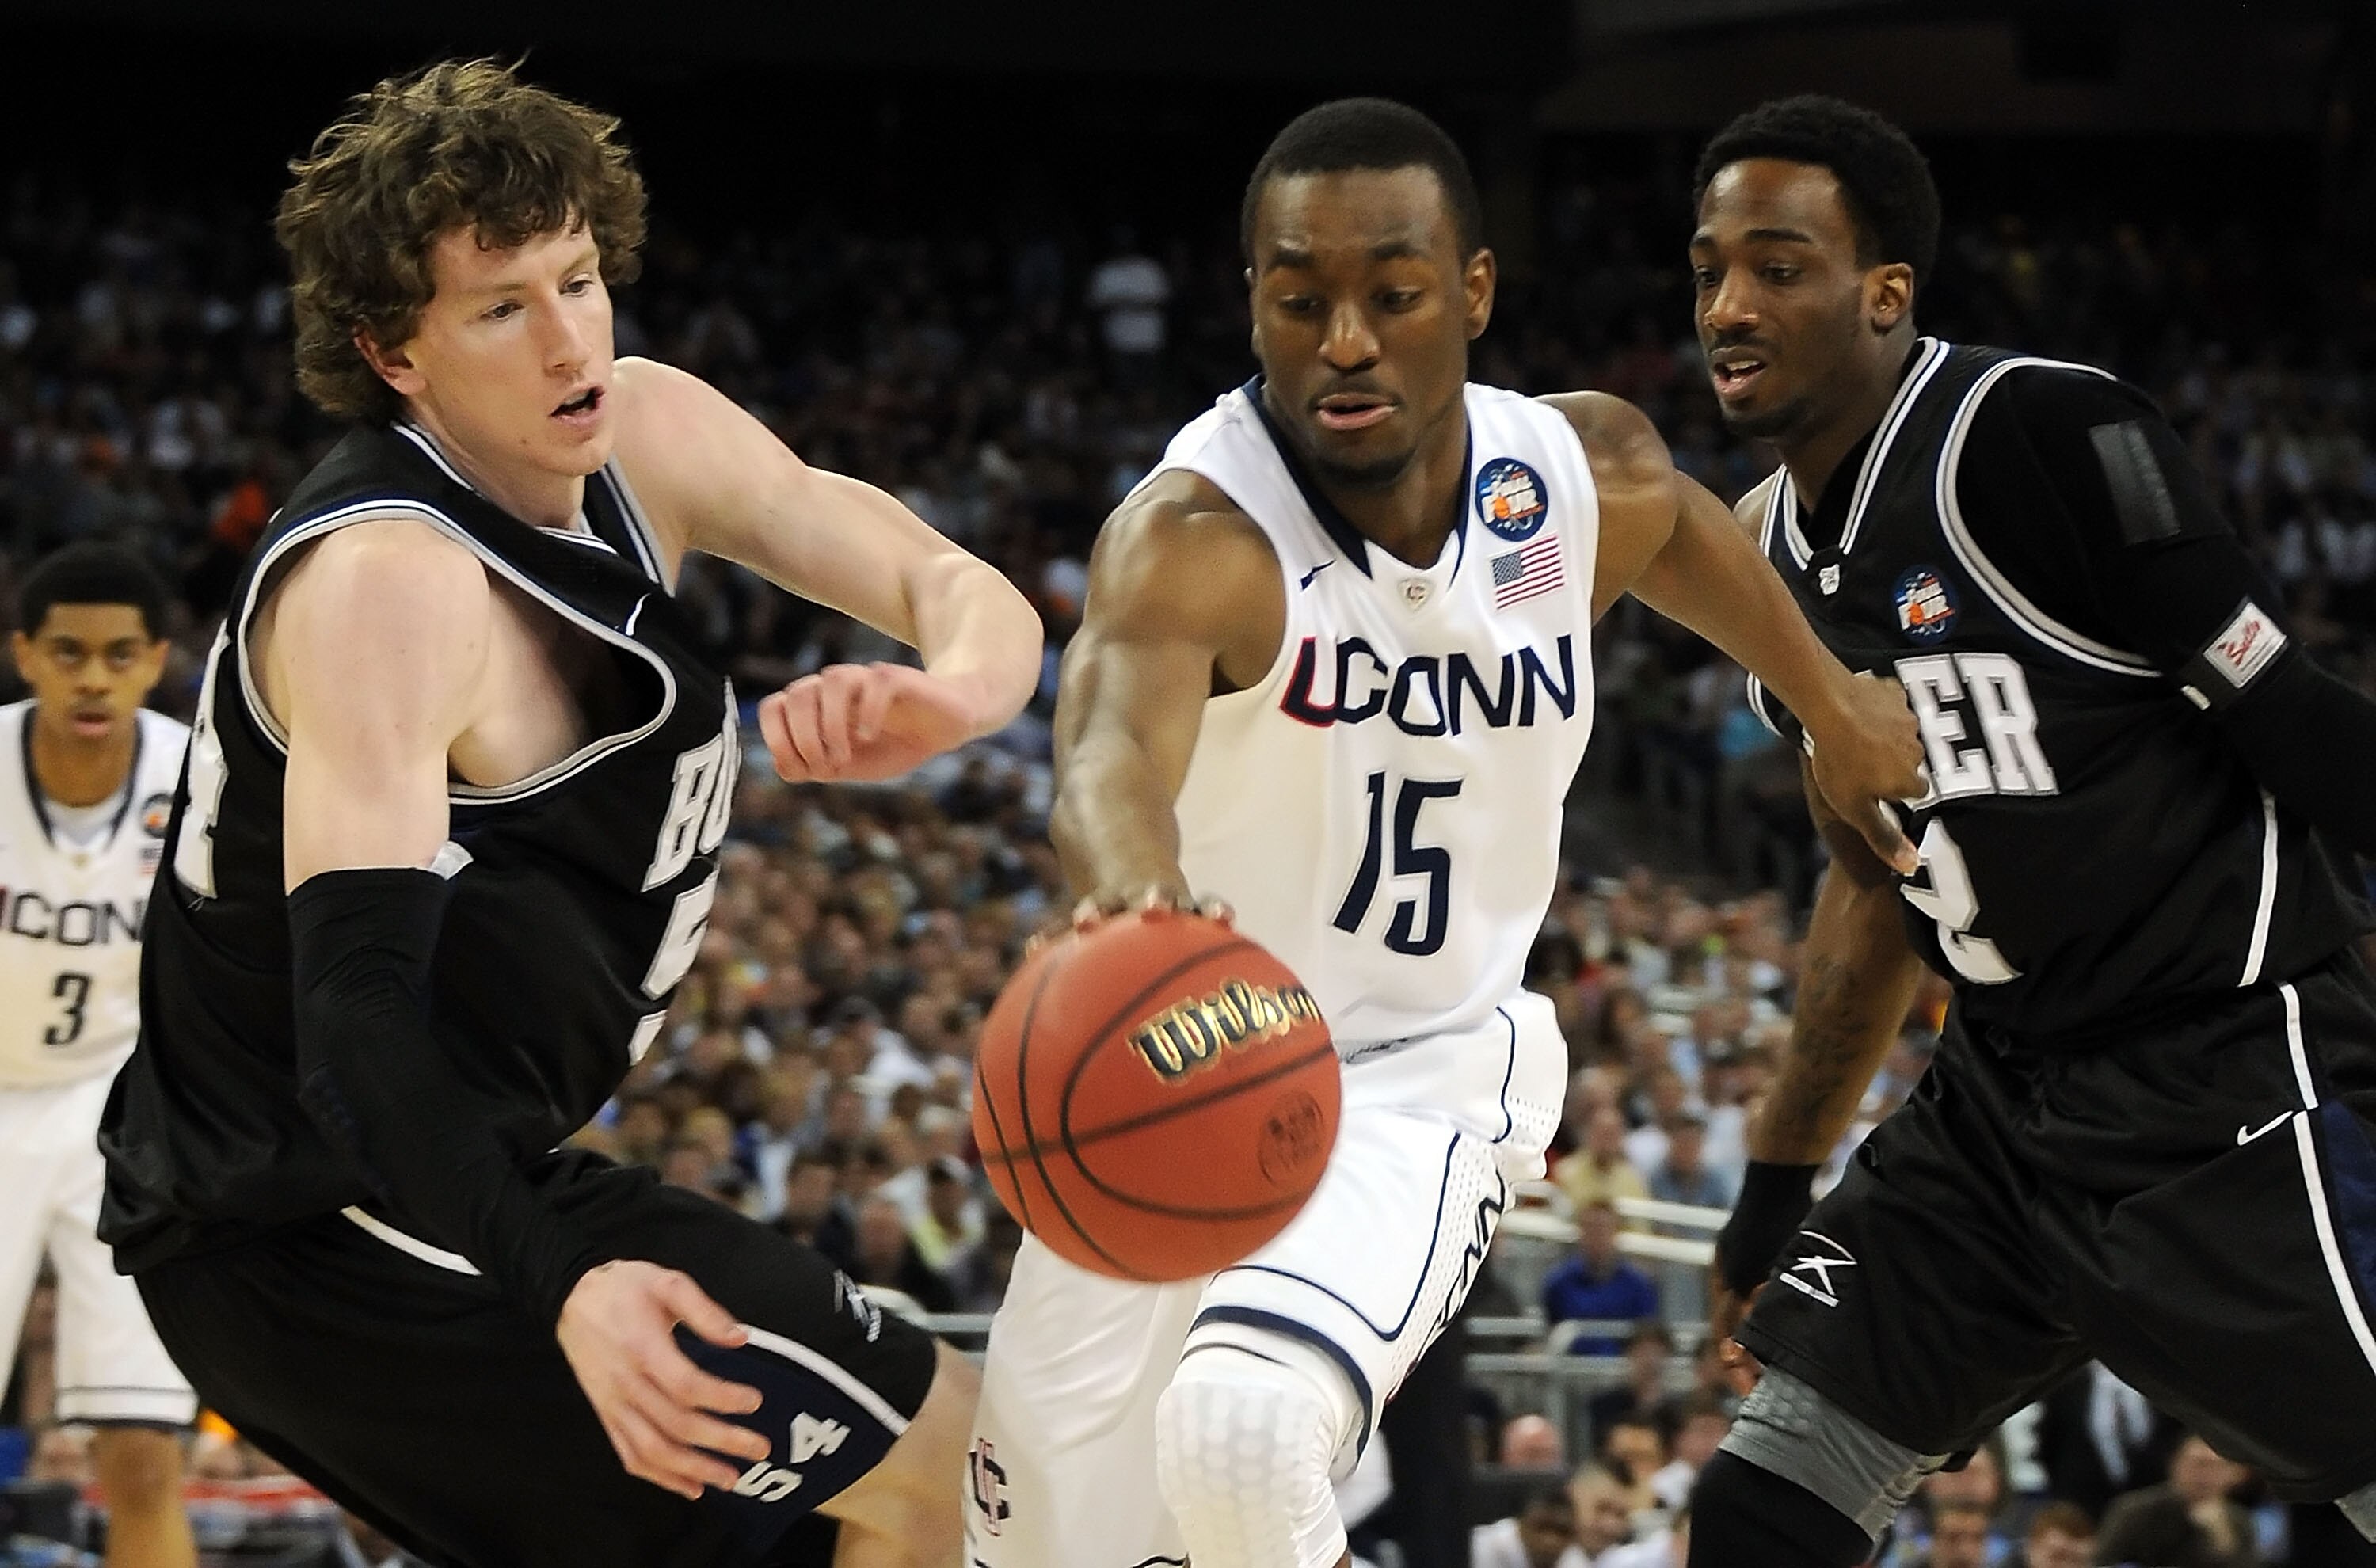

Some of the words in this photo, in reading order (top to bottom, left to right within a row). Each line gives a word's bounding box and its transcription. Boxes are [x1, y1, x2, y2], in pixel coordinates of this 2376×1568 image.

[1278, 634, 1576, 737] UCONN
[1332, 770, 1465, 957] 15
[42, 972, 92, 1047] 3
[1126, 977, 1323, 1087] Wilson
[731, 1411, 853, 1504] 54
